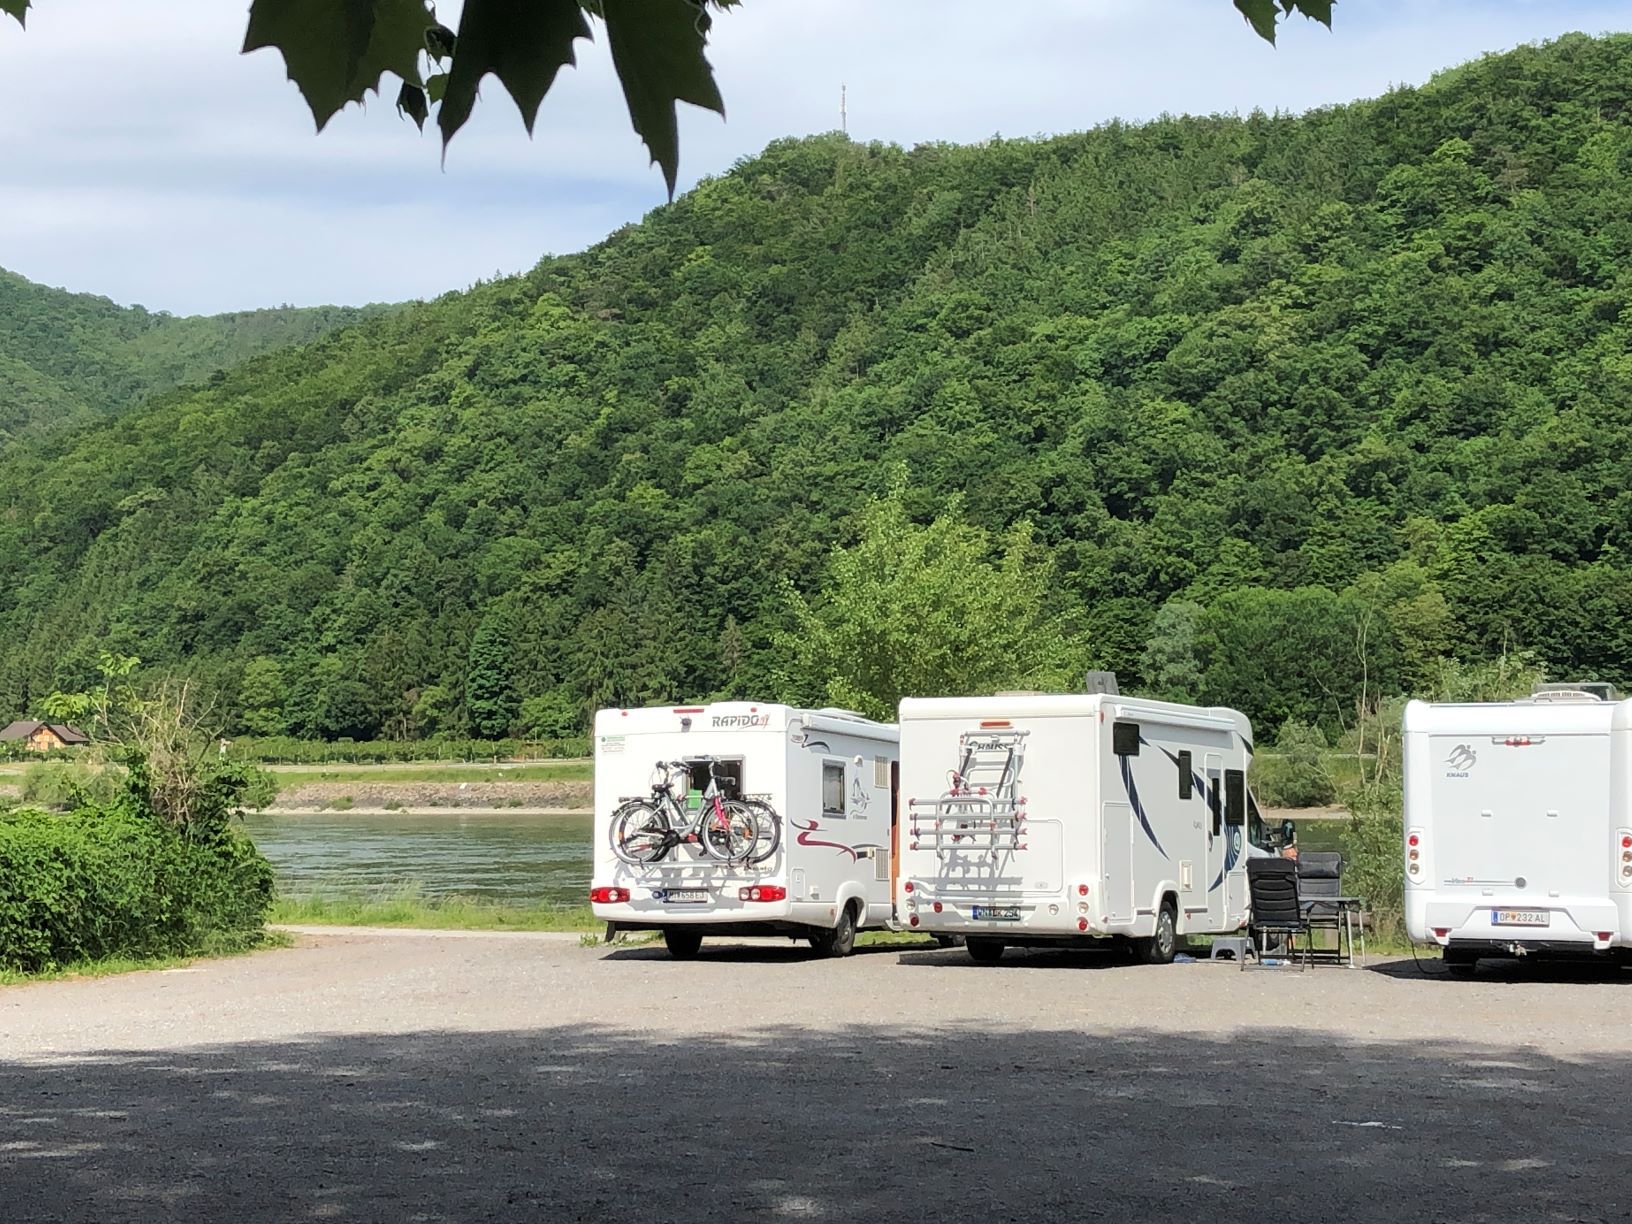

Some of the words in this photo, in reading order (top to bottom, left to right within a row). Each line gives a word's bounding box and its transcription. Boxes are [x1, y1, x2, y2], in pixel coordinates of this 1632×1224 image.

[711, 714, 759, 727] RAPIDO
[1516, 912, 1533, 922] 232
[1534, 913, 1545, 924] AL
